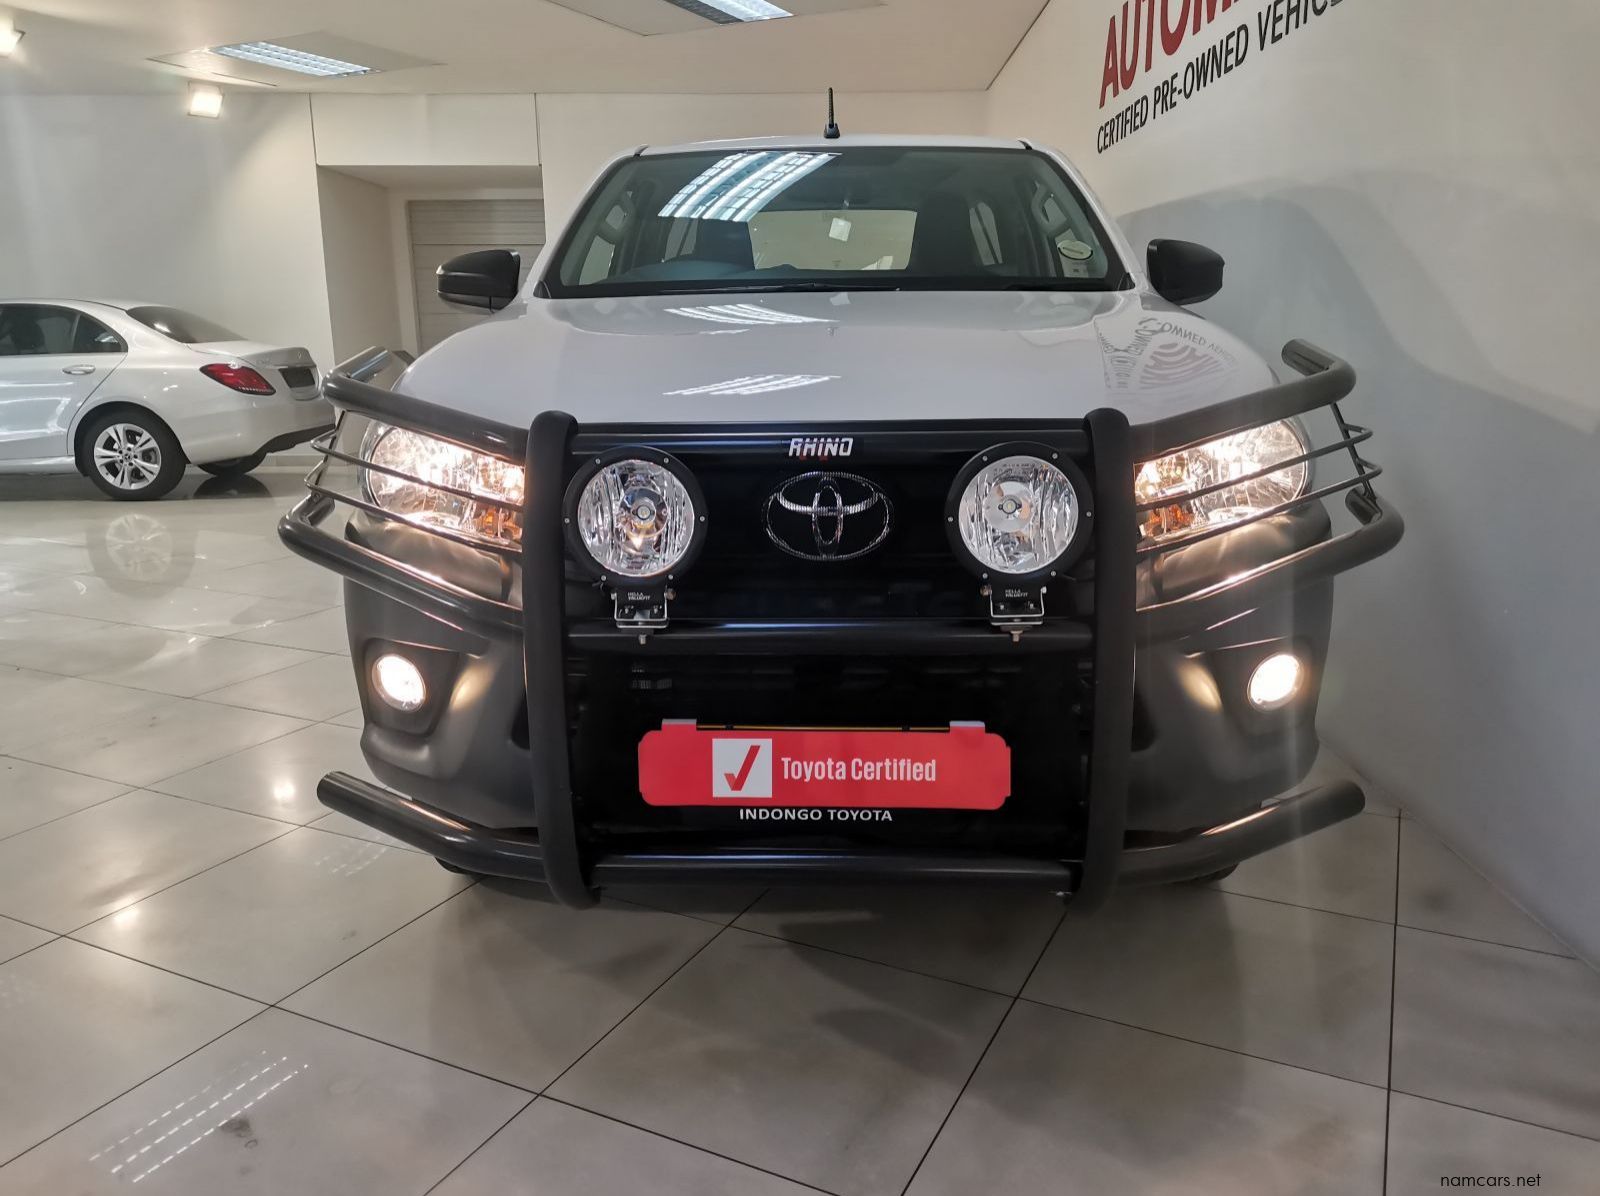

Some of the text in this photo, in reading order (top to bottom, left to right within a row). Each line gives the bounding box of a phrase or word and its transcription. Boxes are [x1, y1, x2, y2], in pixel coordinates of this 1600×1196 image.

[1099, 0, 1240, 109] AUTO
[1096, 0, 1341, 154] CERTIFIED PRE-OWNED VEHI
[788, 437, 854, 457] RHINO
[781, 757, 937, 783] Toyota Certified
[739, 808, 893, 822] INDONGO TOYOTA
